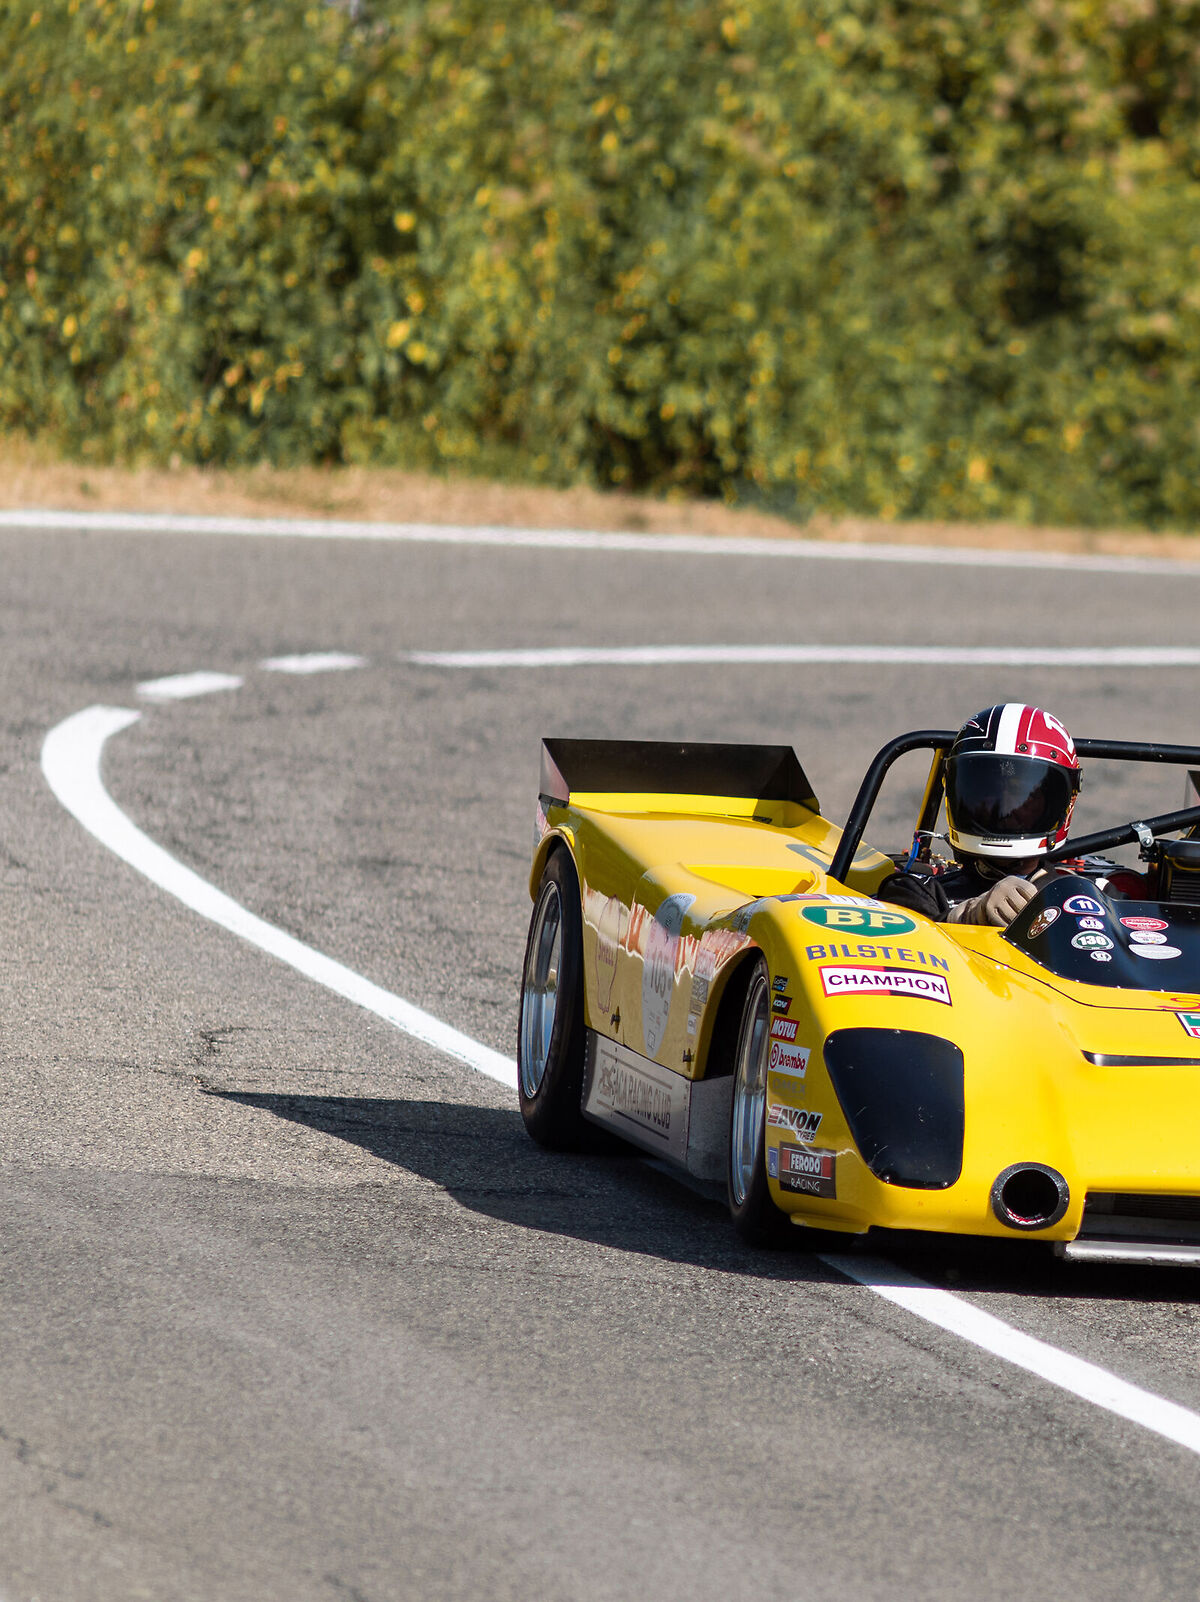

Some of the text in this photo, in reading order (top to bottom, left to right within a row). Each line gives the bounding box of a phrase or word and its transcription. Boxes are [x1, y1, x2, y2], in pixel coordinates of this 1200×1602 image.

[824, 908, 906, 929] BP
[805, 944, 950, 972] BILSTEIN
[828, 974, 945, 994] CHAMPION
[771, 1019, 797, 1039] MOTUL
[778, 1049, 806, 1070] brembo
[778, 1108, 822, 1132] AVON
[796, 1130, 815, 1141] TYRES
[790, 1153, 821, 1174] FERODO
[790, 1177, 820, 1192] RACING
